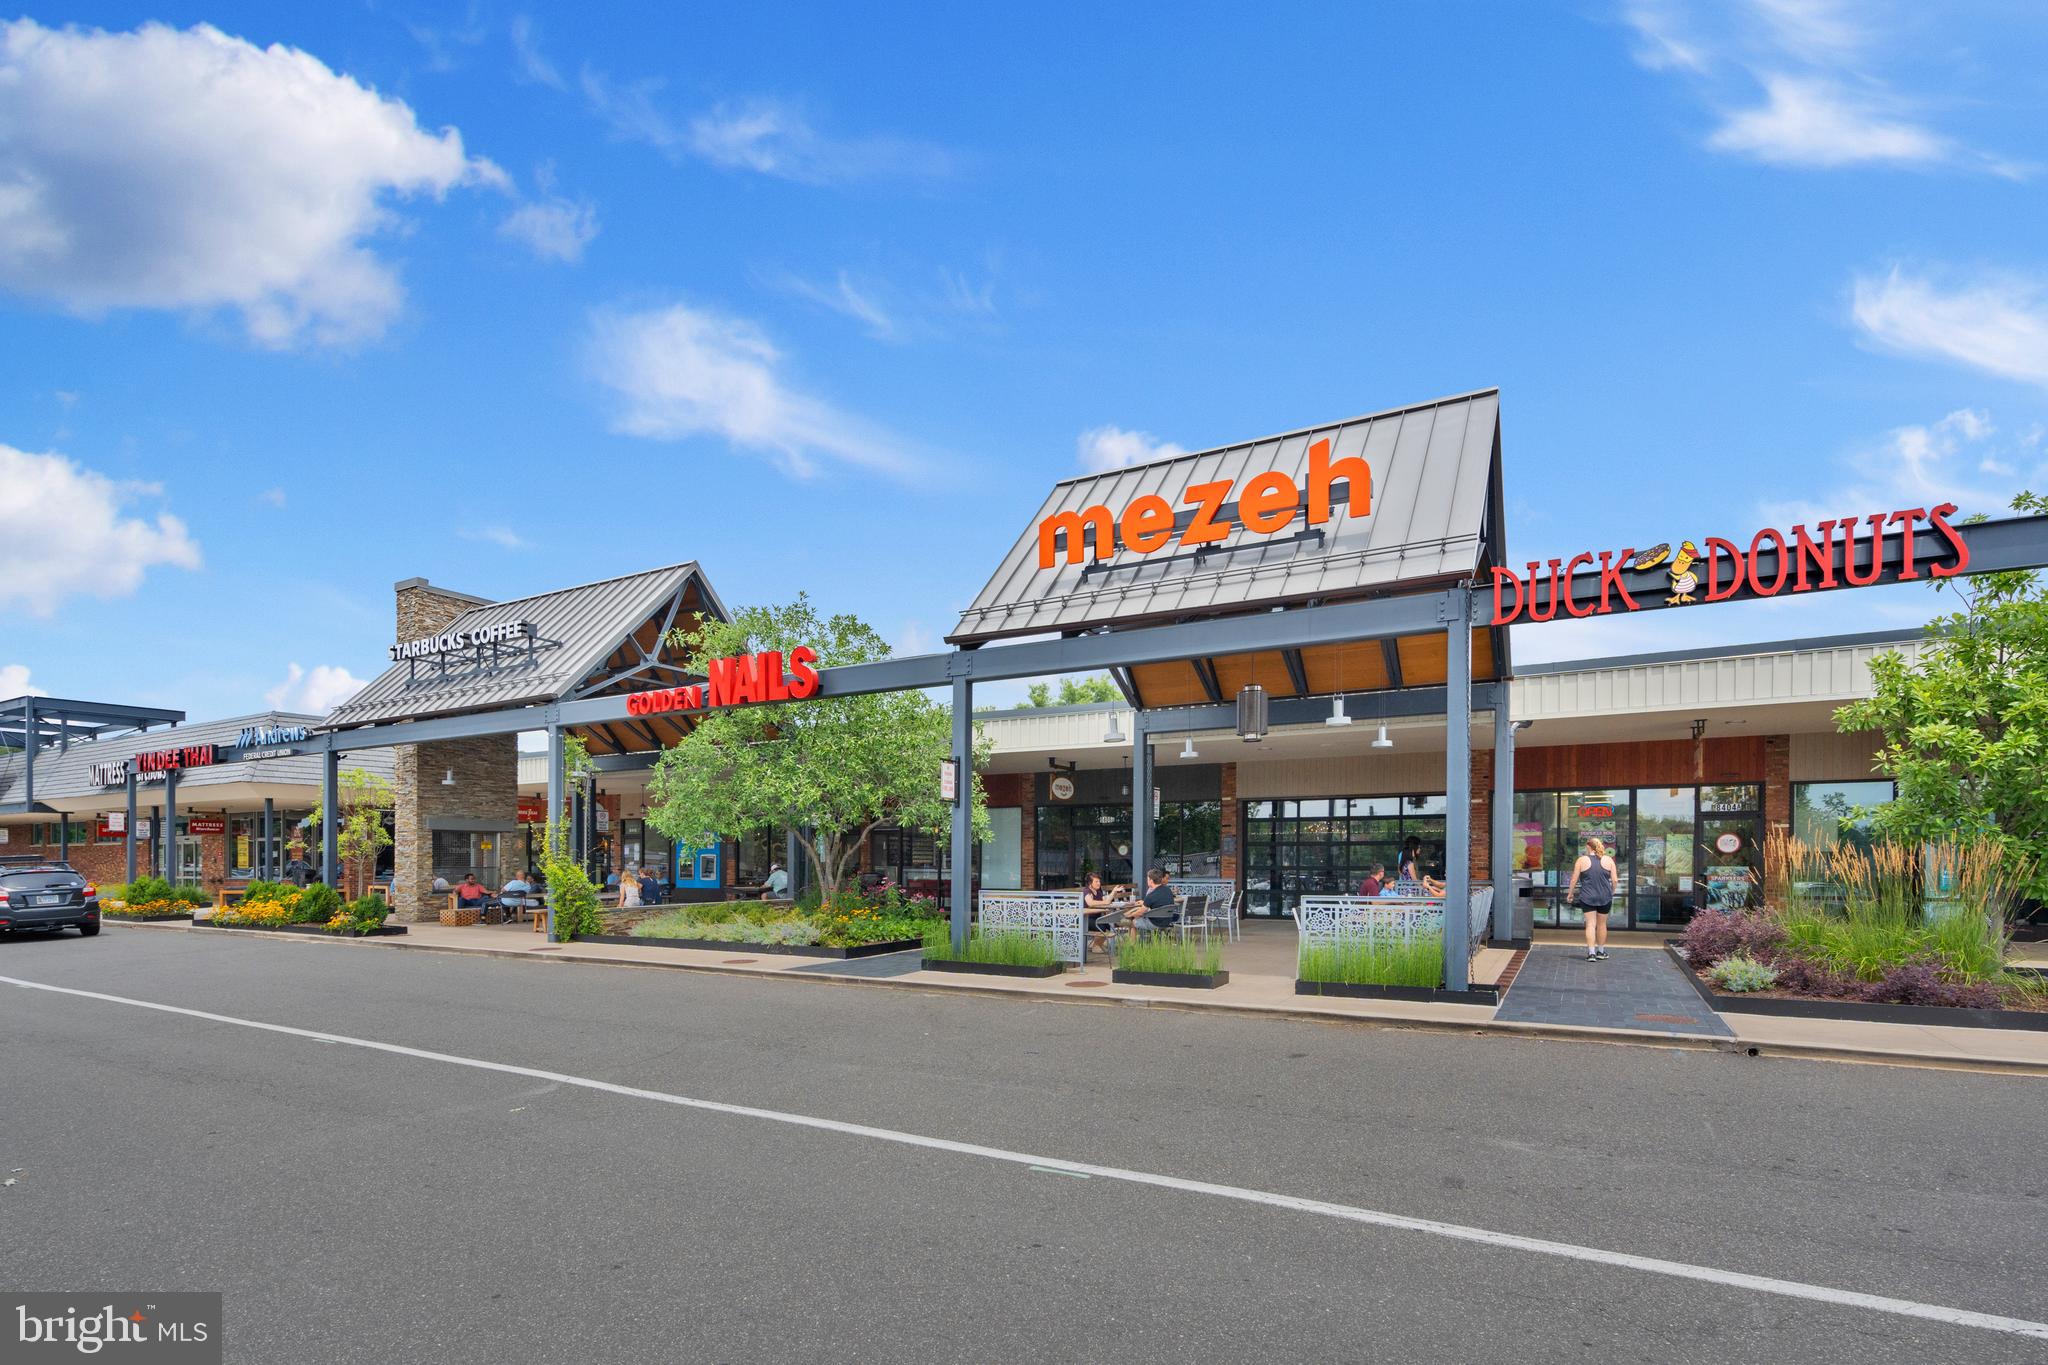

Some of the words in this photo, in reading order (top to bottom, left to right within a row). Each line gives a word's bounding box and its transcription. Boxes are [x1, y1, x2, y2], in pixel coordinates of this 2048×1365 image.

[1039, 438, 1372, 569] mezeh
[1490, 548, 1641, 626] DUCK
[1704, 502, 1970, 602] DONUTS
[388, 632, 464, 660] STARBUCKS
[471, 620, 522, 645] COFFEE
[626, 685, 702, 717] GOLDEN
[708, 645, 819, 708] NAILS
[254, 724, 305, 745] Andrews
[136, 749, 180, 771] YINDEE
[183, 743, 214, 768] THAI
[243, 752, 261, 760] FEDERAL
[261, 750, 277, 759] CREDIT
[276, 748, 291, 757] UNION
[88, 761, 126, 787] MATTRESS
[1577, 805, 1613, 817] OPEN
